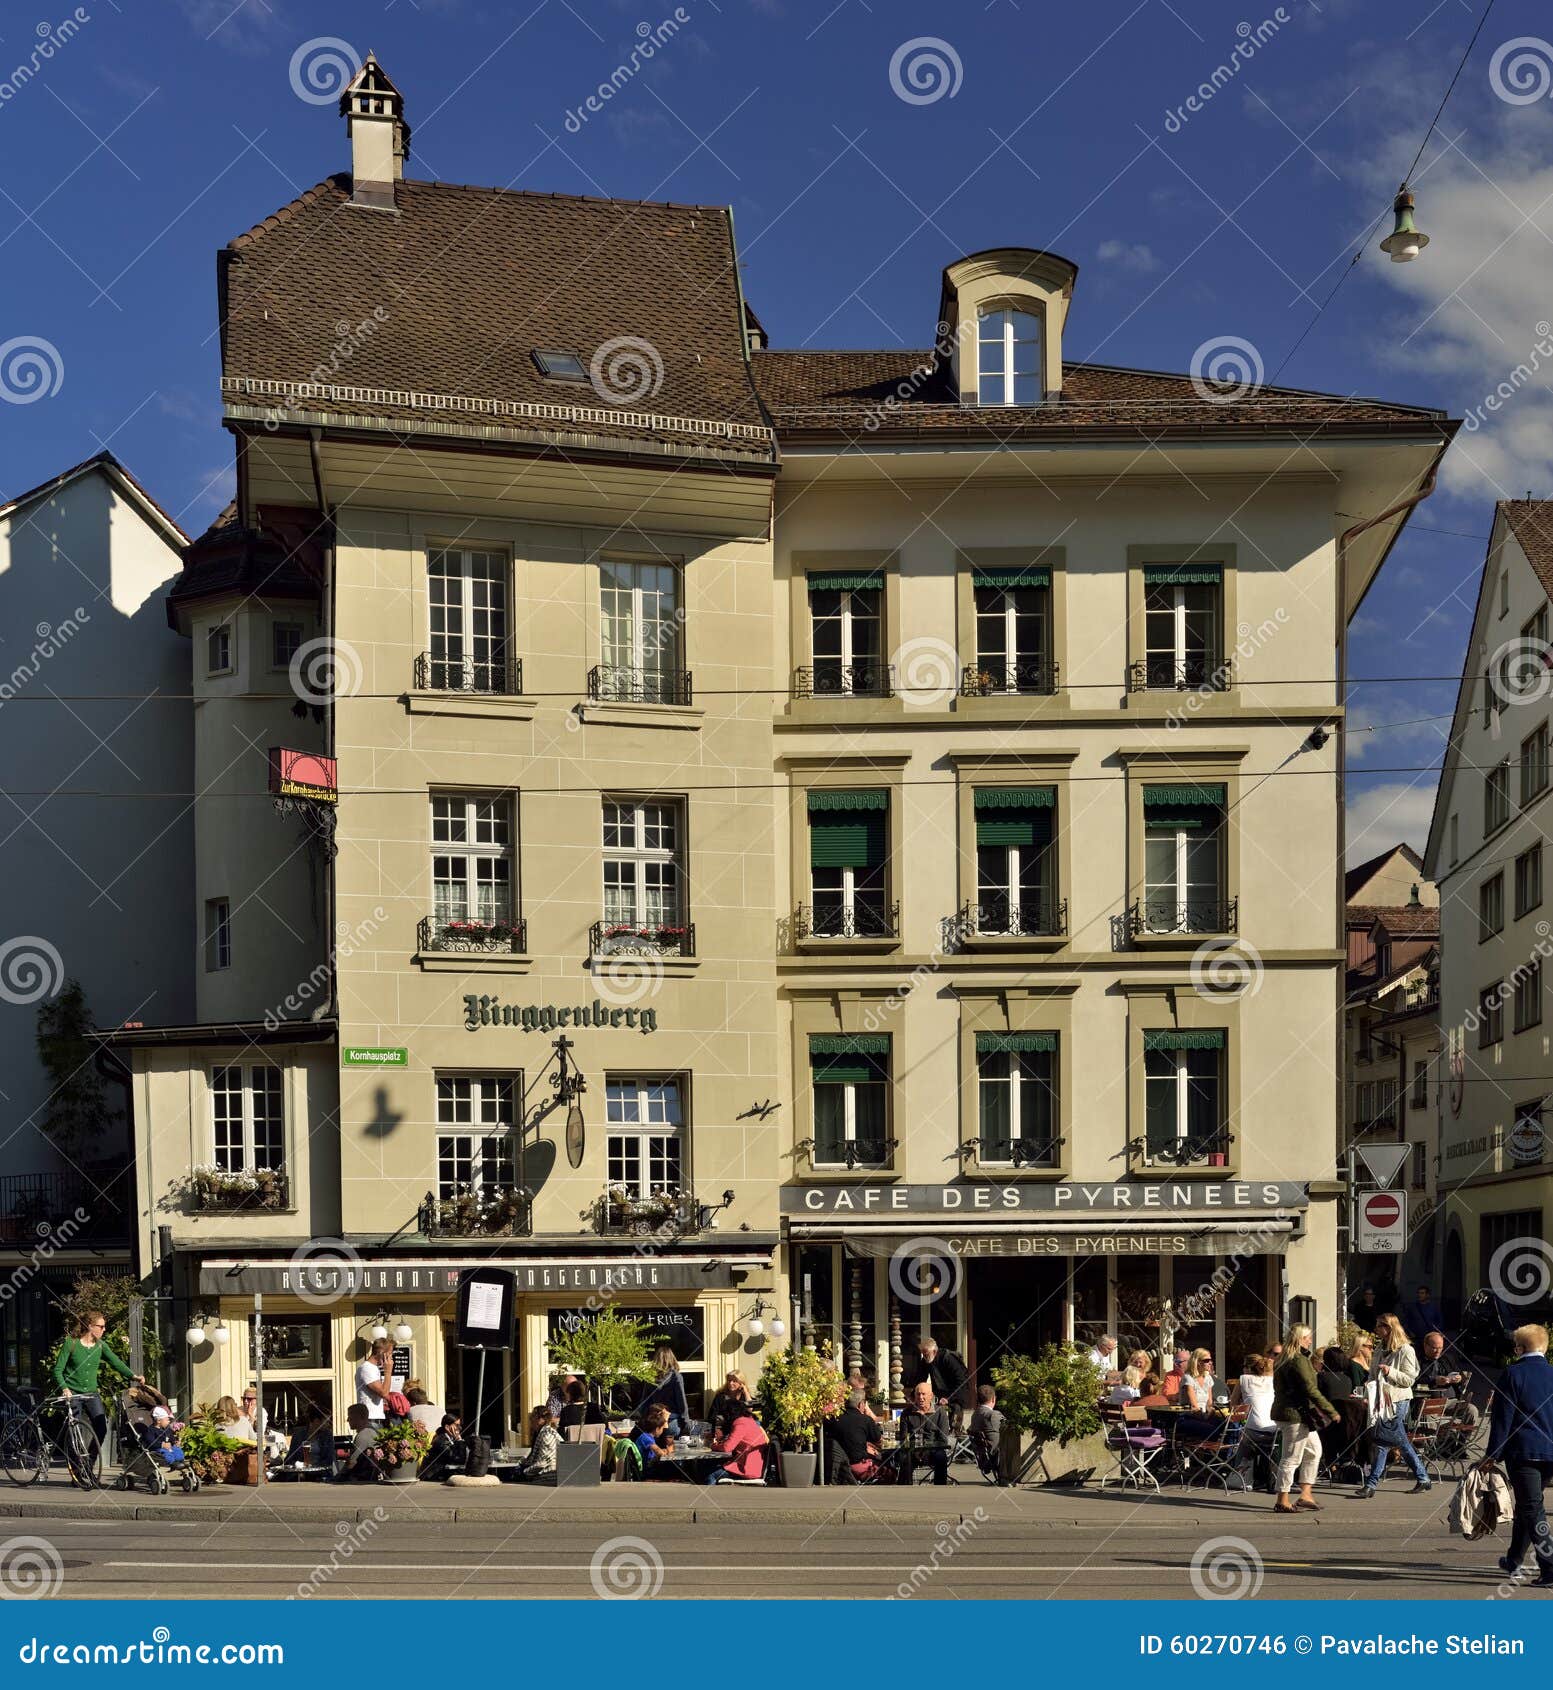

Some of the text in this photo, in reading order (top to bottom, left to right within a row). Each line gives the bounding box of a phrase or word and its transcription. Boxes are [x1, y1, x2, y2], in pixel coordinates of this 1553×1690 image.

[463, 994, 658, 1035] Ringgenberg
[349, 1049, 402, 1063] Kornhausplatz
[805, 1185, 1281, 1210] CAFE DES PYRENEES
[948, 1236, 1186, 1254] CAFE DES PYRENEES
[282, 1271, 435, 1289] RESTAURANT
